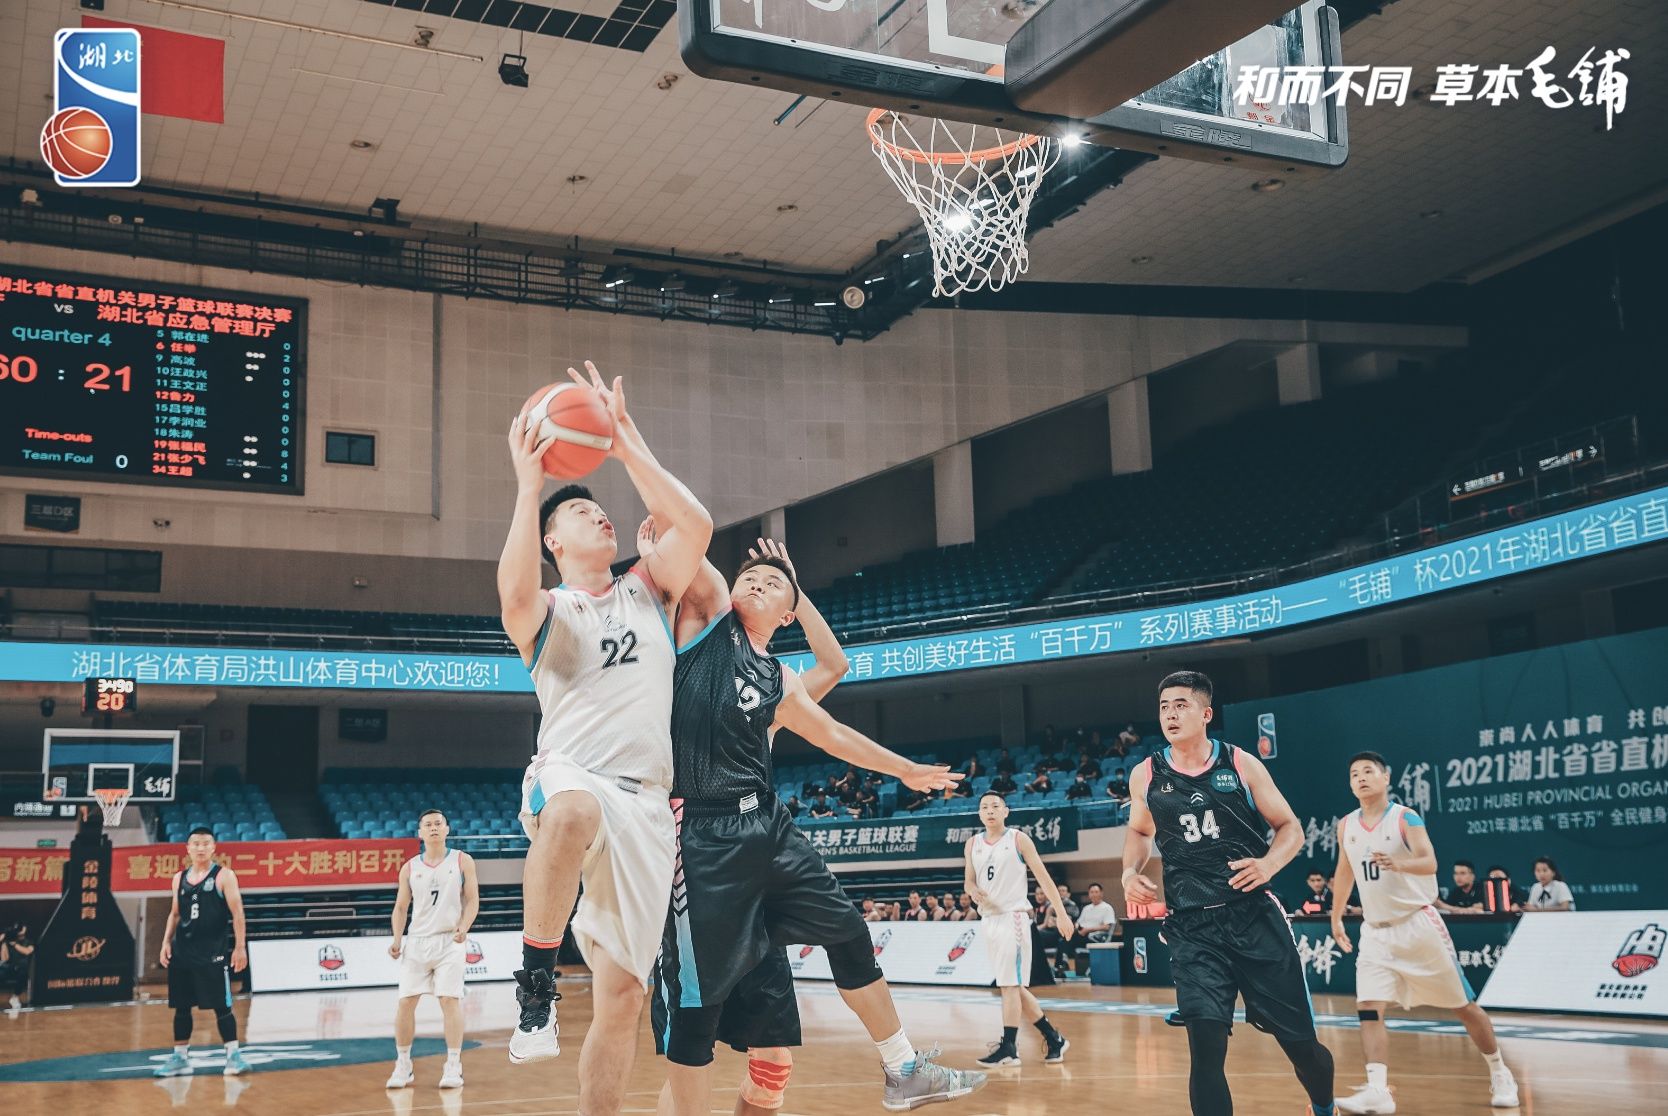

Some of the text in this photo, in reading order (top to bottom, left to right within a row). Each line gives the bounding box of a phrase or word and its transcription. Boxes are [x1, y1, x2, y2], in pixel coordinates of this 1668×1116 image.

[54, 303, 74, 314] VS
[97, 304, 276, 338] 湖北省应急管理厅
[12, 326, 112, 347] quarter 4
[283, 342, 291, 350] 0
[283, 354, 291, 363] 2
[83, 363, 131, 392] 21
[282, 366, 290, 375] 0
[170, 380, 208, 392] 王文正
[282, 390, 290, 398] 0
[282, 378, 290, 387] 0
[282, 402, 289, 410] 4
[282, 414, 289, 422] 0
[25, 427, 93, 443] Time-outs
[281, 426, 289, 434] 0
[281, 438, 289, 446] 0
[22, 449, 129, 469] Team Foul 0
[280, 462, 288, 470] 4
[280, 474, 288, 482] 3
[881, 633, 1016, 675] 共创美好生活
[1030, 621, 1123, 657] “百千万”
[1413, 498, 1668, 592] 杯2021年湖北省省直
[600, 629, 638, 670] 22
[71, 650, 500, 688] 湖北省体育局洪山体育中心欢迎您！
[96, 694, 125, 711] 20
[1479, 715, 1604, 748] 崇尚人人体育
[1449, 797, 1478, 813] 2021
[1484, 791, 1522, 810] HUBEI
[1527, 784, 1613, 806] PROVINCIAL
[1179, 809, 1221, 843] 34
[1467, 815, 1545, 835] 2021年湖北省
[839, 845, 884, 856] BASKETBALL
[885, 843, 917, 853] LEAGUE
[987, 865, 995, 881] 6
[1361, 860, 1380, 882] 10
[430, 889, 440, 907] 7
[190, 903, 200, 920] 6
